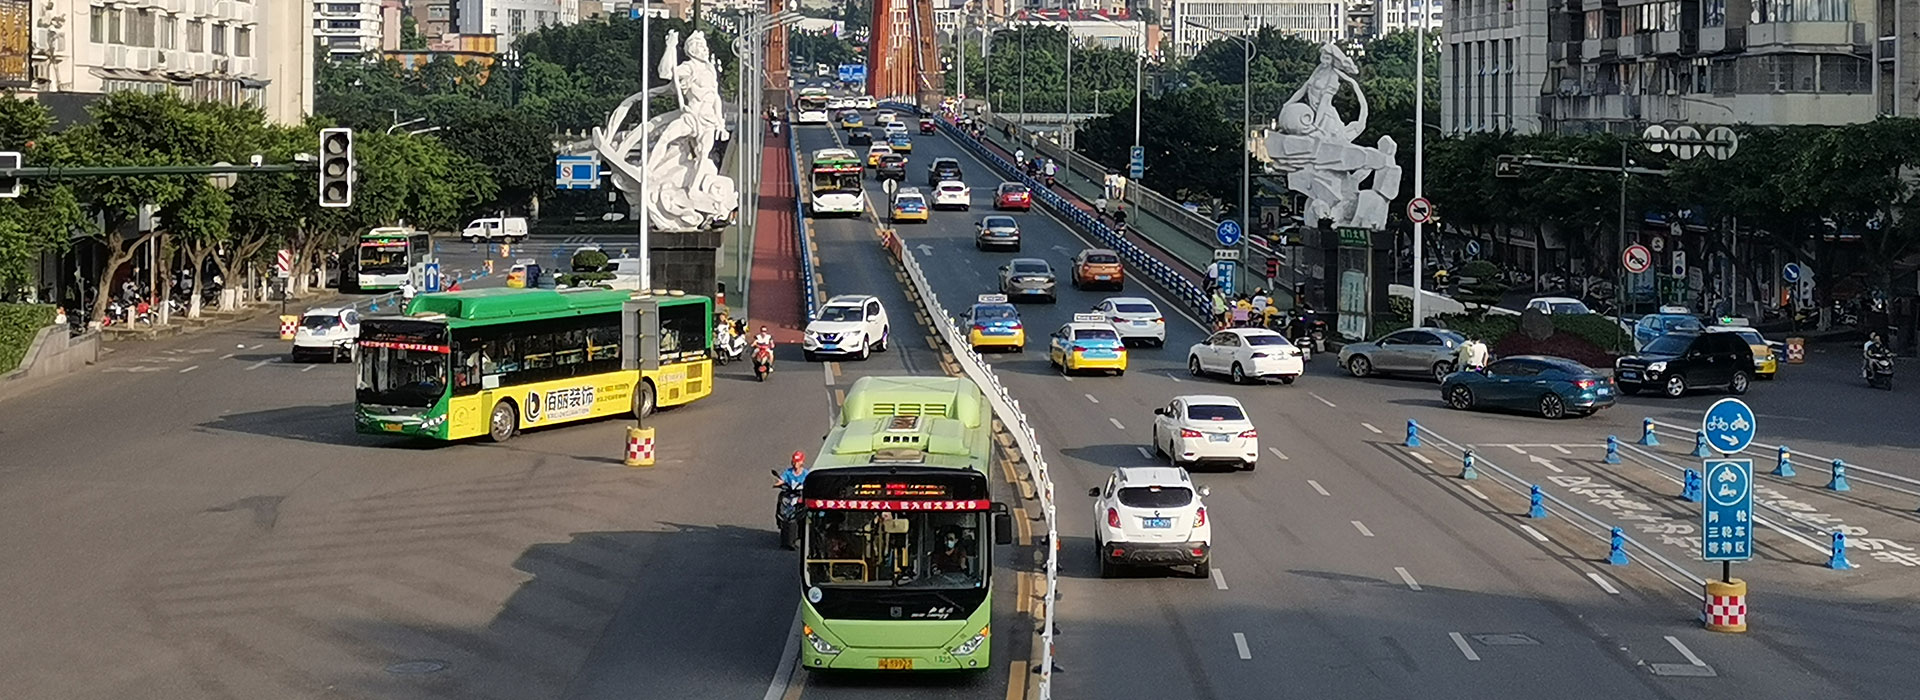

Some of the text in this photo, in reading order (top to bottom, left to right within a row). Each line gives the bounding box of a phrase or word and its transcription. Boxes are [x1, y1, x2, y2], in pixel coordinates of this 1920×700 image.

[545, 385, 594, 412] 佰丽装饰
[1708, 526, 1746, 538] 三轮车
[1708, 541, 1745, 554] 等待区
